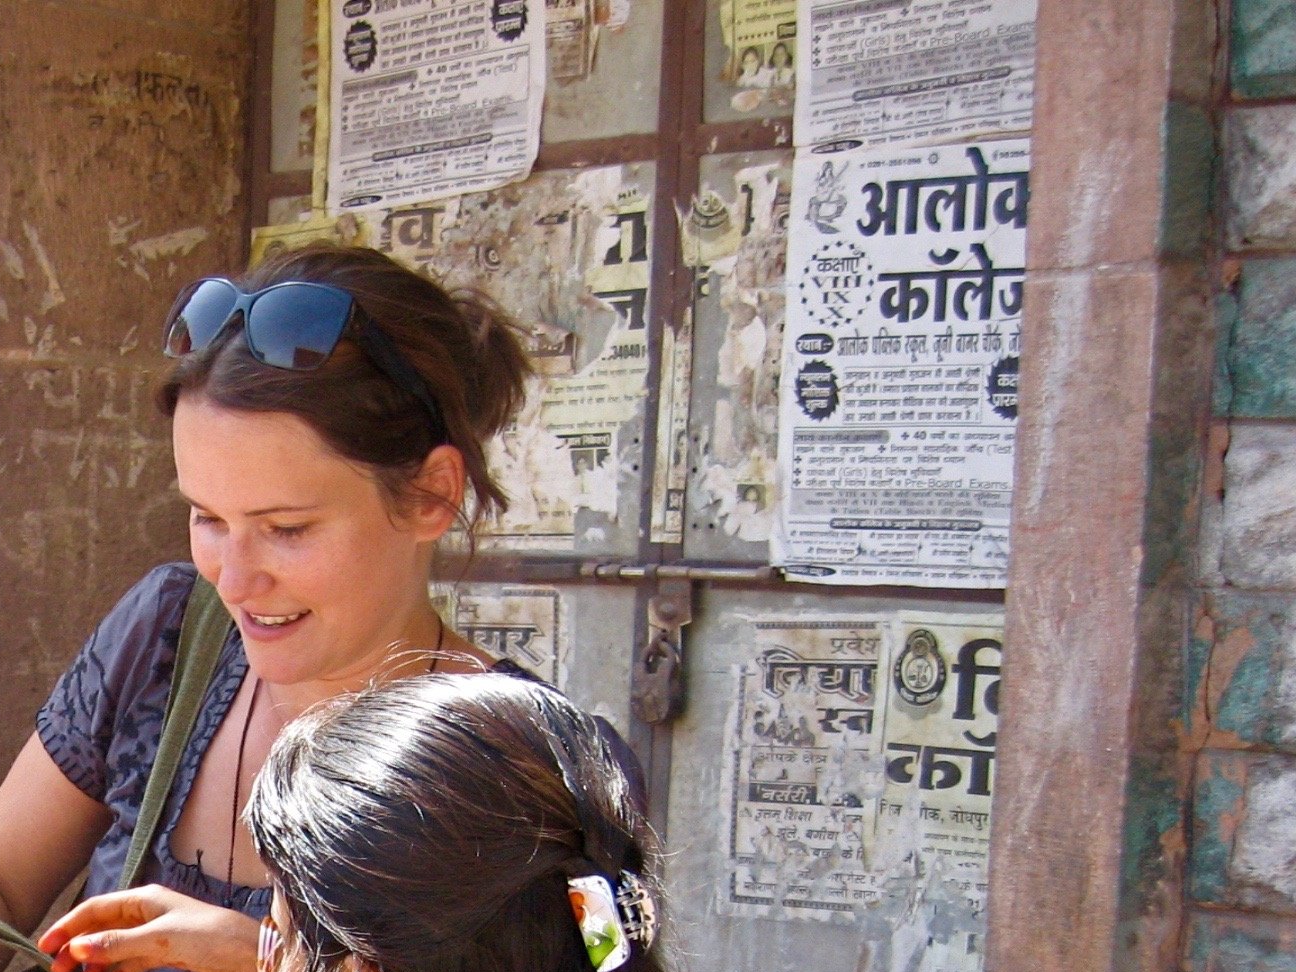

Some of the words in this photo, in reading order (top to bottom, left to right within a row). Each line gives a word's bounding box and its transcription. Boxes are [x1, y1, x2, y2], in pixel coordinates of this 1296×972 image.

[929, 28, 990, 48] Pre-Board
[811, 275, 863, 289] VIII
[823, 291, 851, 304] IX
[828, 307, 848, 320] X
[913, 431, 927, 441] 40
[838, 467, 868, 478] (Girls)
[905, 478, 963, 489] Pre-Board
